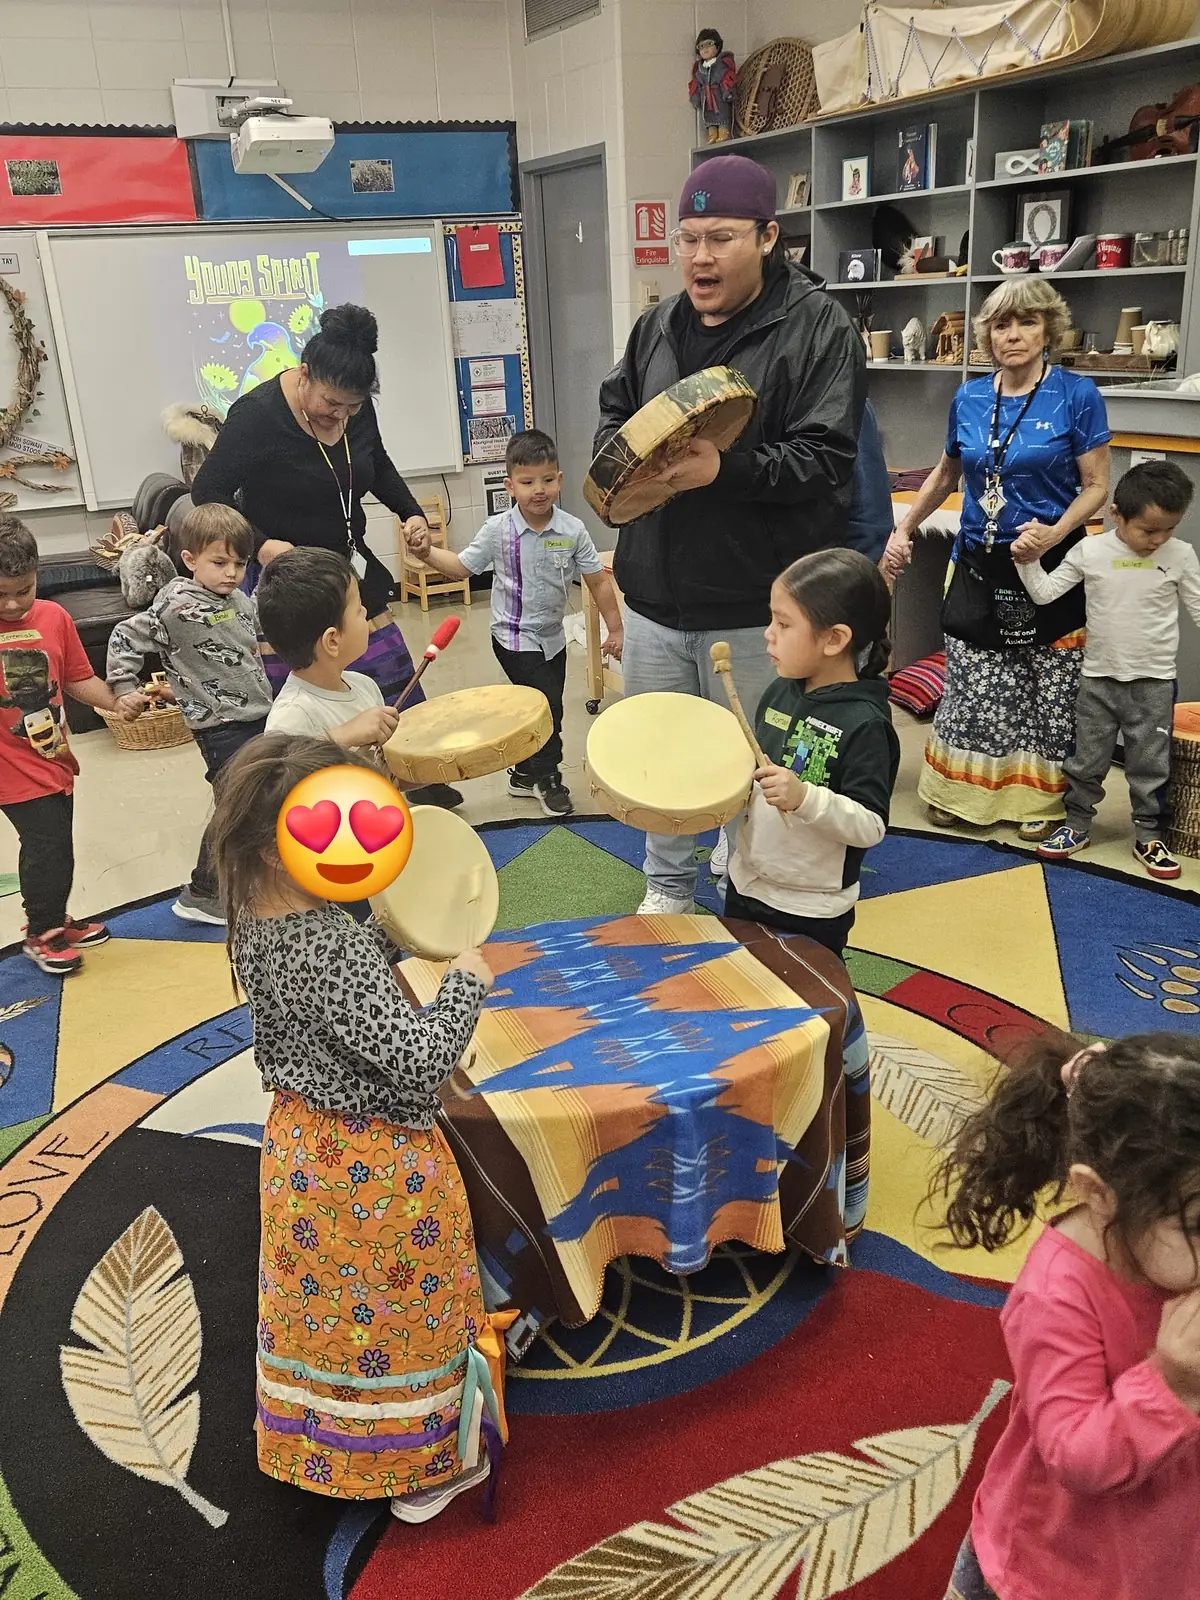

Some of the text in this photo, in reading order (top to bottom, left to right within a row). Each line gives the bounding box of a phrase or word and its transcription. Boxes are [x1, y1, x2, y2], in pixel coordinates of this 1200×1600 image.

[1, 257, 13, 265] TAY
[636, 256, 668, 264] Extinguisher
[994, 594, 1014, 602] HEAD
[0, 632, 36, 642] Jeremiah
[804, 715, 844, 738] MINECRAFT
[0, 1131, 110, 1256] LOVE
